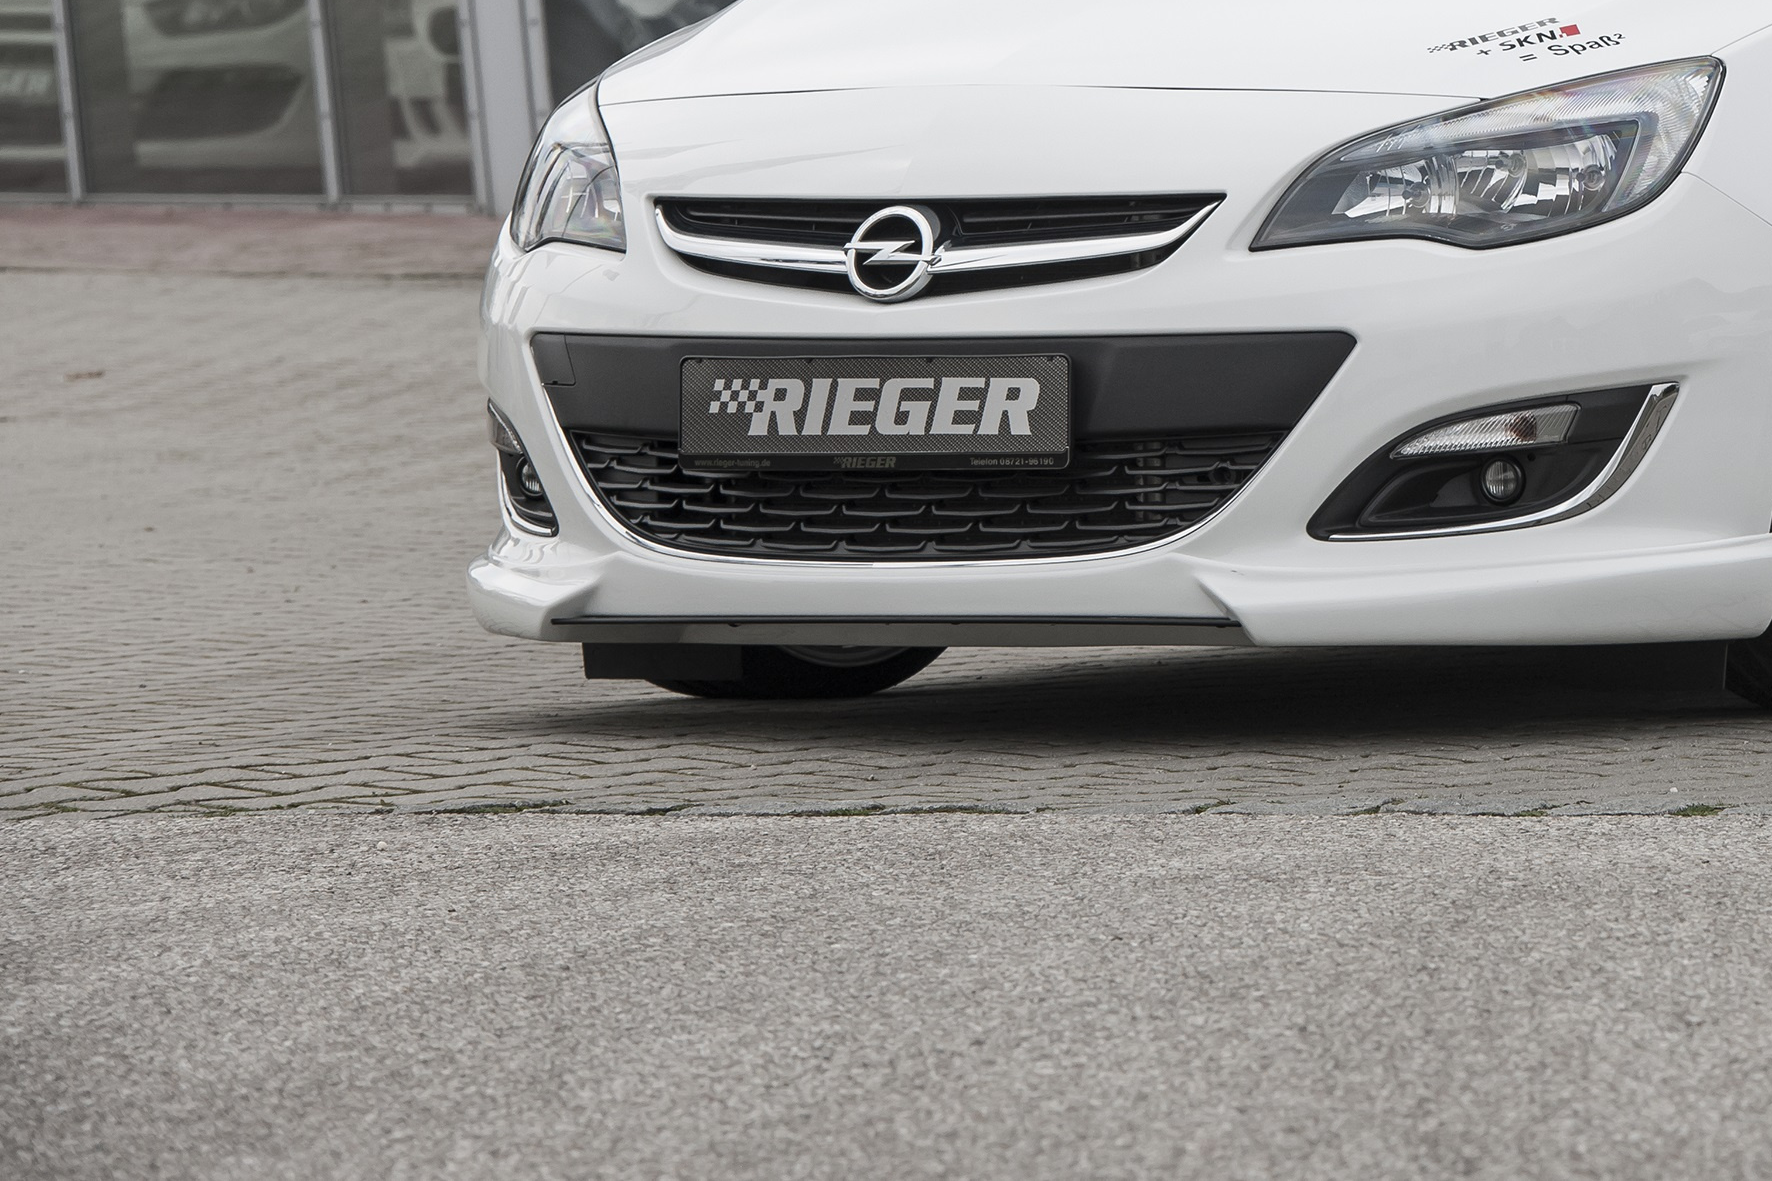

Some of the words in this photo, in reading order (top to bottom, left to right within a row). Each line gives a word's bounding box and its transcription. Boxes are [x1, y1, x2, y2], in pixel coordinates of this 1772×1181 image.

[1449, 17, 1560, 51] RIEGER
[748, 377, 1040, 436] RIEGER
[841, 456, 896, 469] RIEGER
